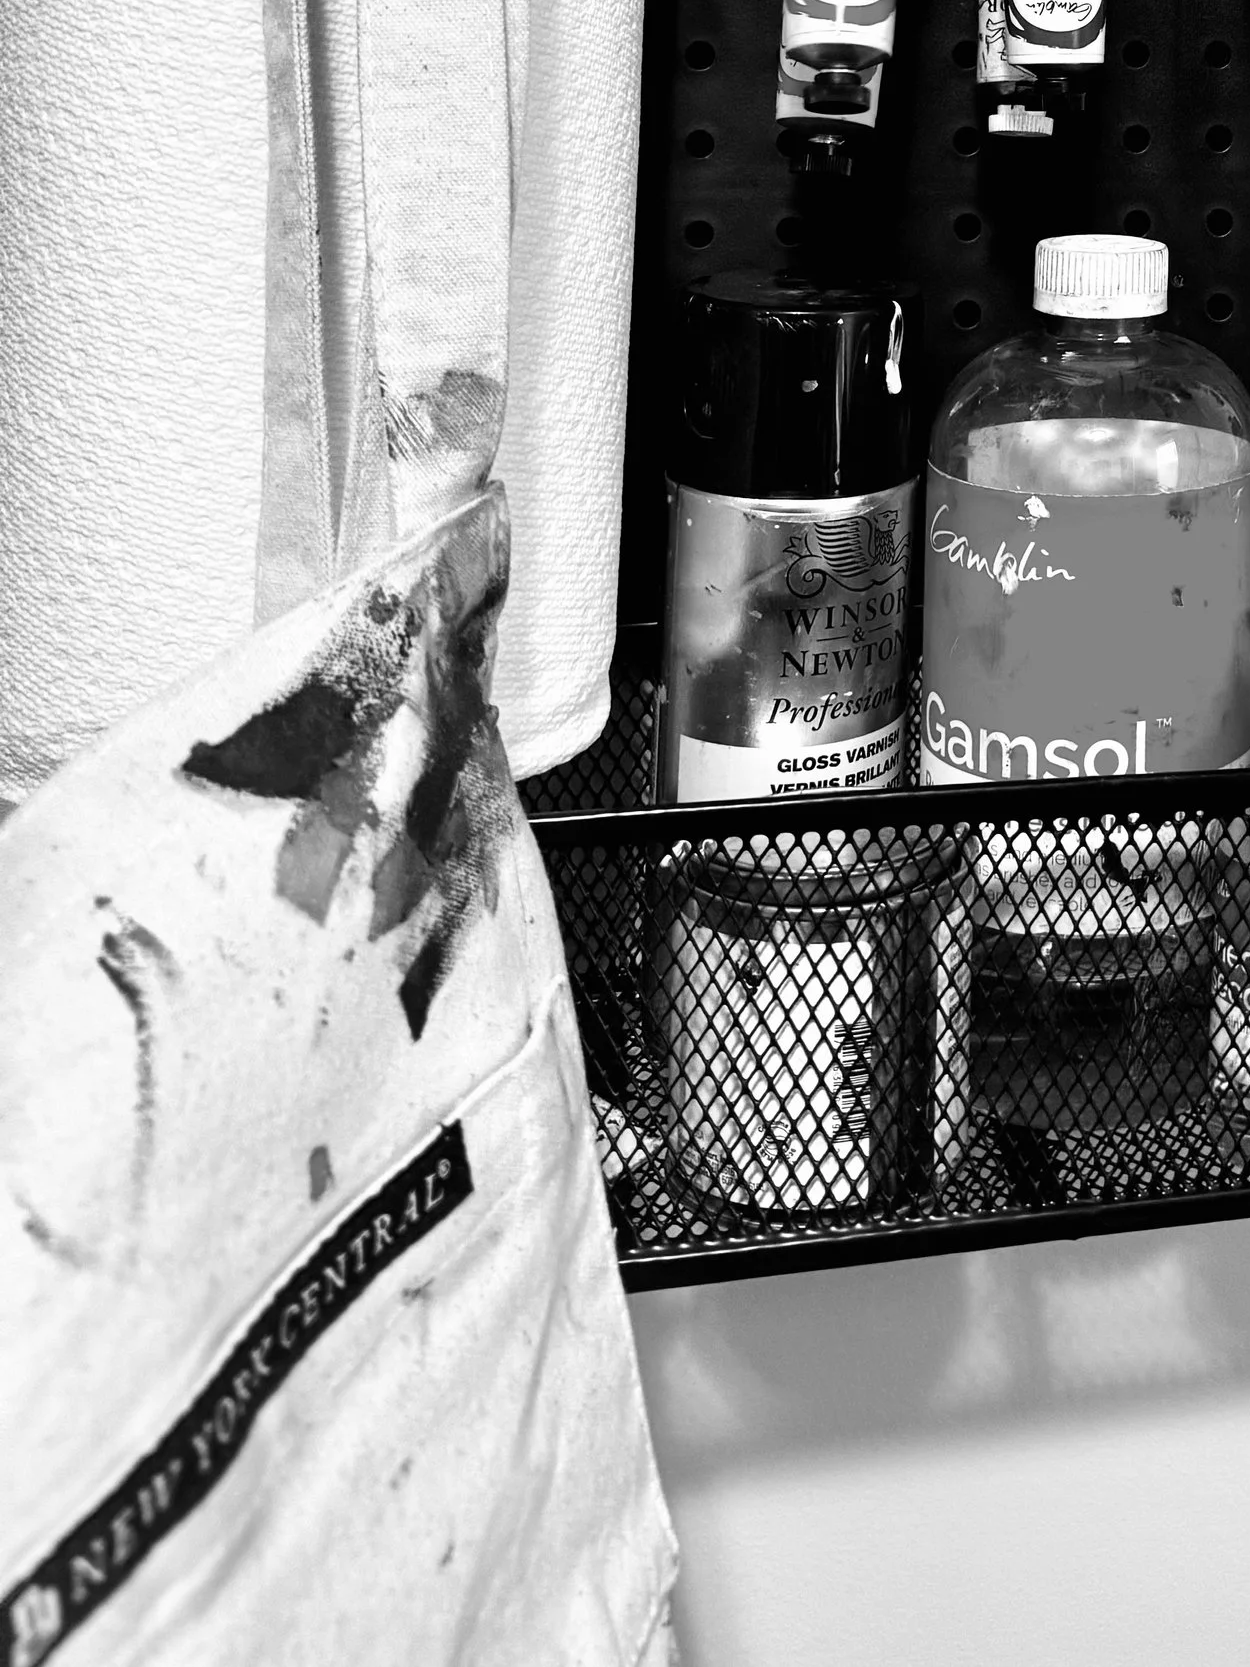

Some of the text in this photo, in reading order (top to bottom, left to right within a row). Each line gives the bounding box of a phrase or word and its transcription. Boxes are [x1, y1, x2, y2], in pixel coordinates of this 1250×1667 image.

[1025, 0, 1093, 22] Gamblin
[929, 504, 1076, 583] Gamblin
[782, 586, 906, 636] WINSOR
[851, 626, 866, 644] &
[777, 727, 901, 774] GLOSS VARNISH
[844, 749, 901, 788] BRILLANT
[72, 1456, 184, 1605] NEW
[192, 1335, 274, 1473] YORK
